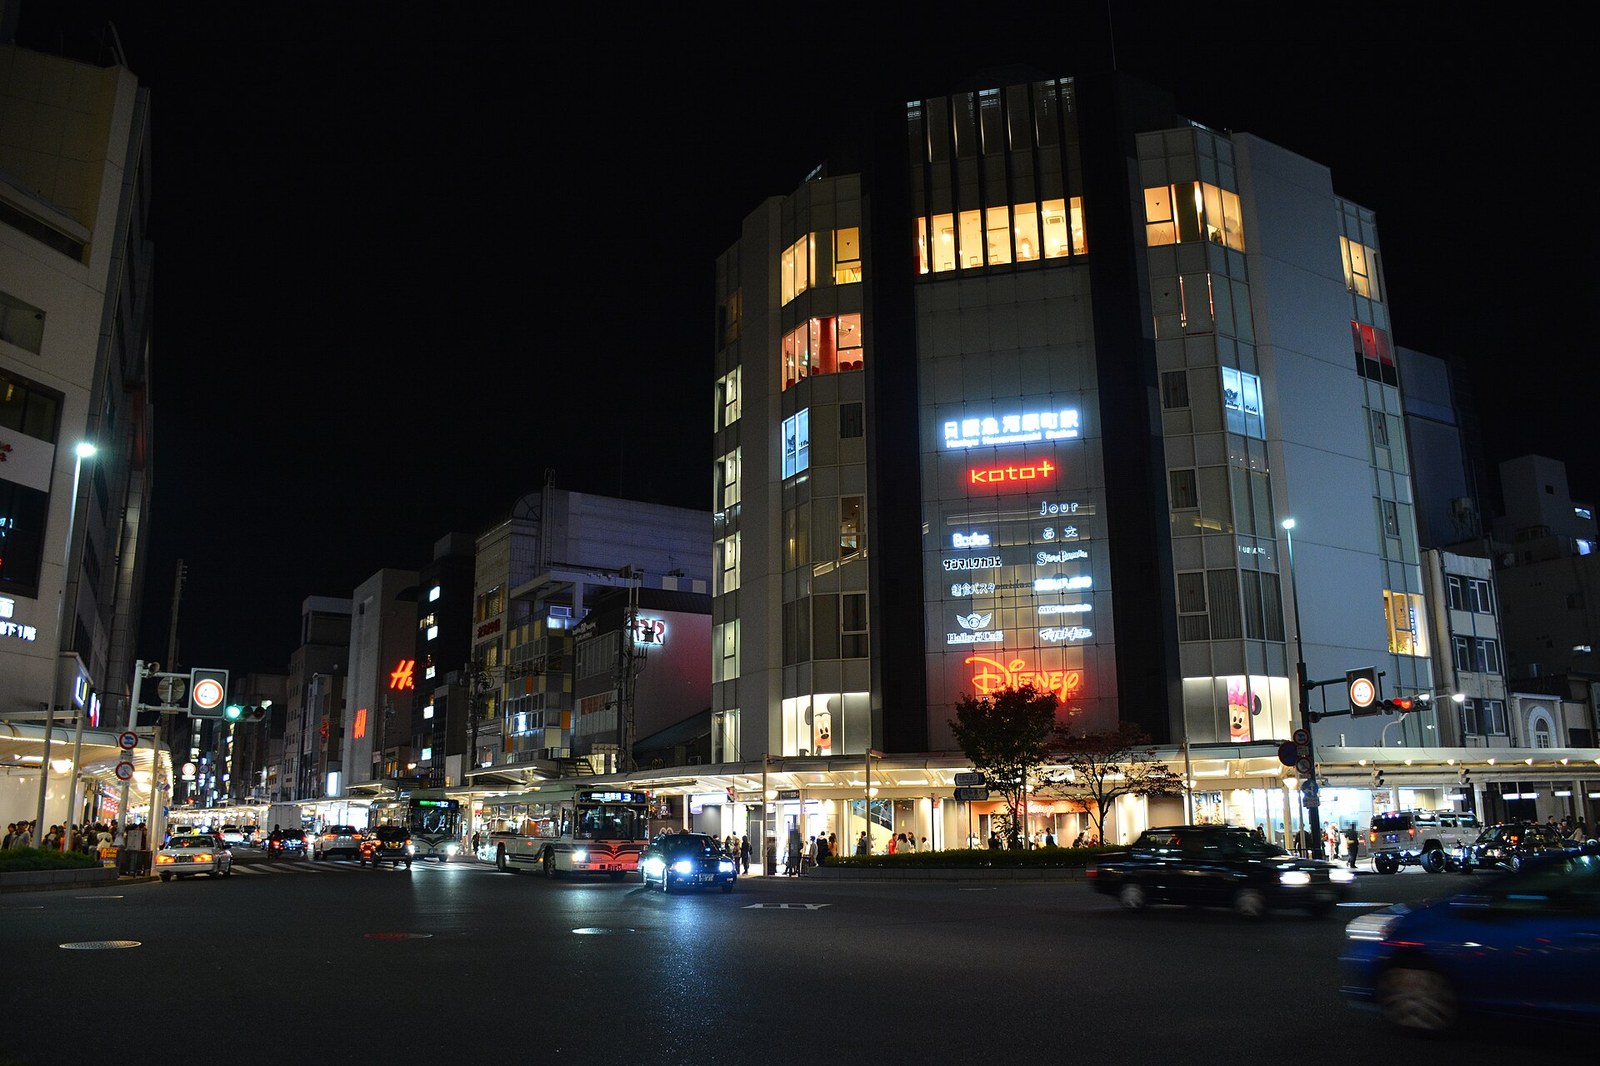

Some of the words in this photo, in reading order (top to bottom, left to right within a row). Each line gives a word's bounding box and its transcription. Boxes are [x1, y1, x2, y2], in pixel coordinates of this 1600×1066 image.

[943, 556, 1002, 571] サンマルクカフェ
[390, 659, 415, 691] H&
